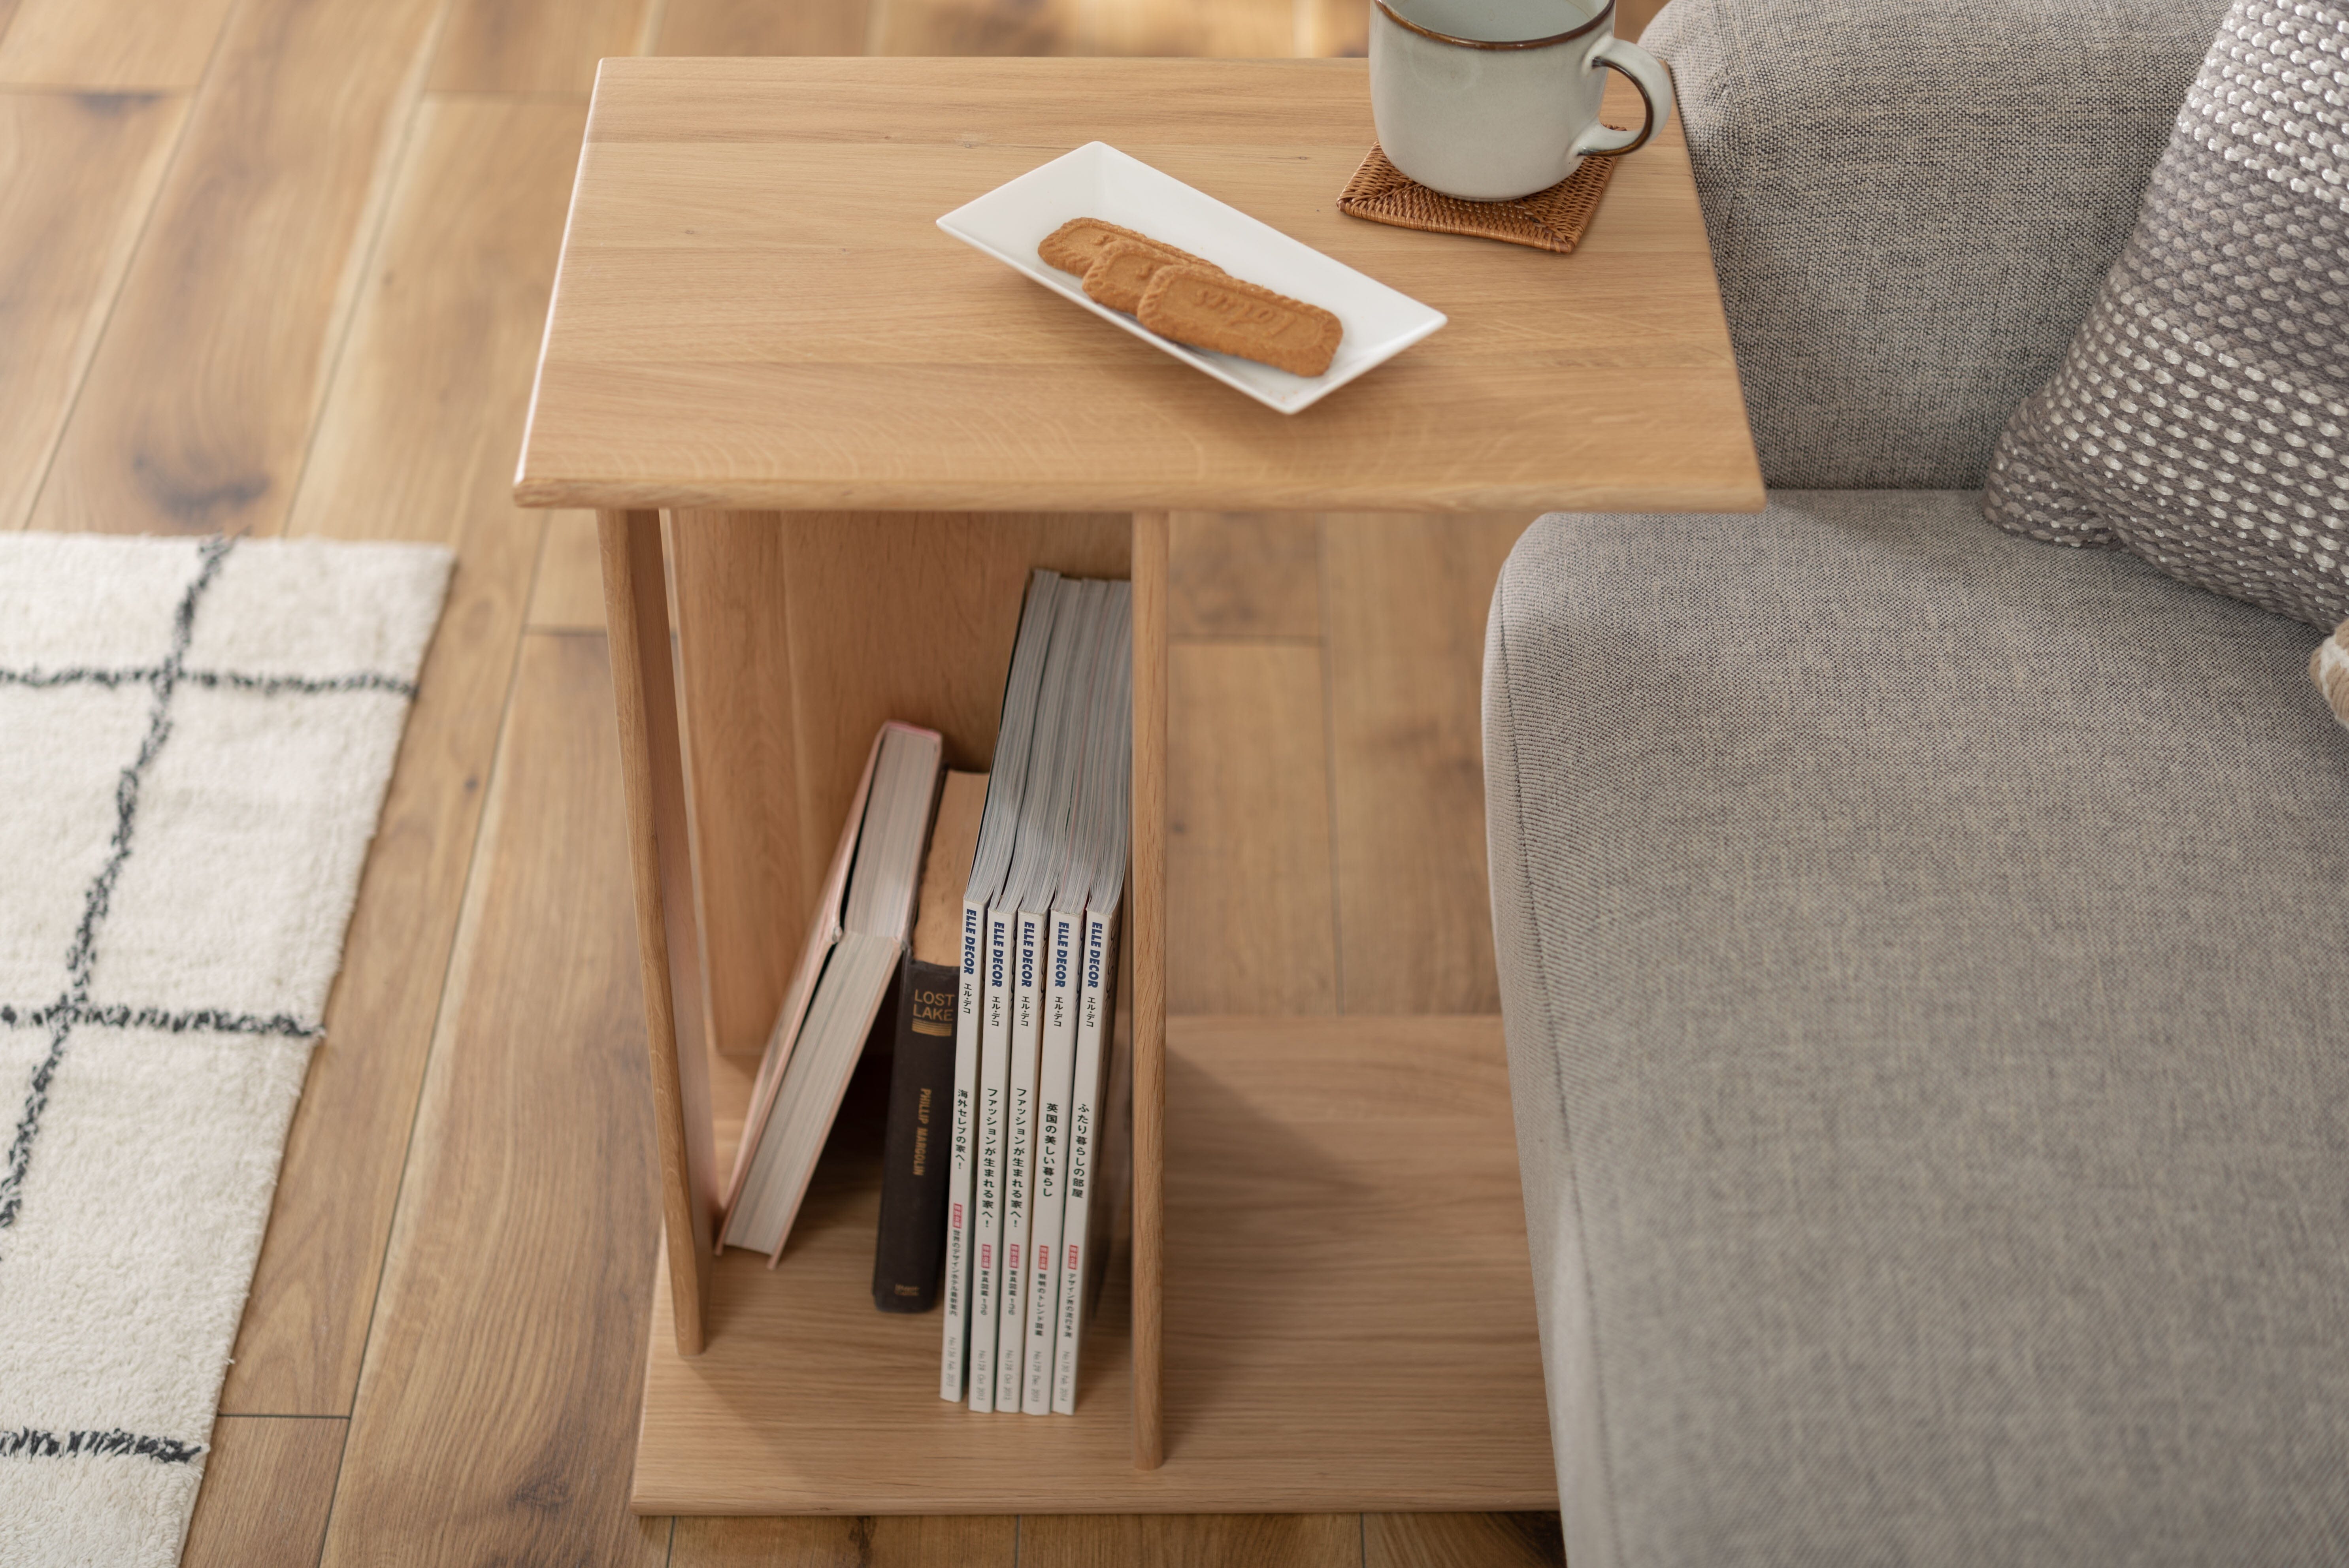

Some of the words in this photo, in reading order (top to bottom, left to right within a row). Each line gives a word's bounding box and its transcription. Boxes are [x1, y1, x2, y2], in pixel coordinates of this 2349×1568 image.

[966, 909, 977, 935] ELLE
[993, 922, 1005, 947] ELLE
[1023, 922, 1035, 947] ELLE
[1058, 922, 1069, 947] ELLE
[1091, 922, 1103, 948] ELLE
[964, 936, 975, 975] DECOR
[992, 949, 1003, 987] DECOR
[1021, 949, 1033, 987] DECOR
[1055, 949, 1068, 988] DECOR
[1088, 949, 1101, 988] DECOR
[913, 1004, 953, 1021] LAKE
[914, 989, 955, 1006] LOST
[963, 983, 972, 1014] エル・デコ
[991, 996, 1001, 1027] エル・デコ
[1021, 996, 1030, 1027] エル・デコ
[1054, 996, 1063, 1027] エル・デコ
[1086, 997, 1096, 1027] エル・デコ
[918, 1088, 932, 1124] PHILLIP
[956, 1089, 968, 1169] 海外セレブの家へ！
[982, 1088, 997, 1227] ファッションが生まれる家へ！
[1010, 1088, 1027, 1227] ファッションが生まれる家へ！
[1043, 1103, 1058, 1197] 英国の美しい暮らし
[1072, 1104, 1089, 1198] ふたり暮らしの部屋
